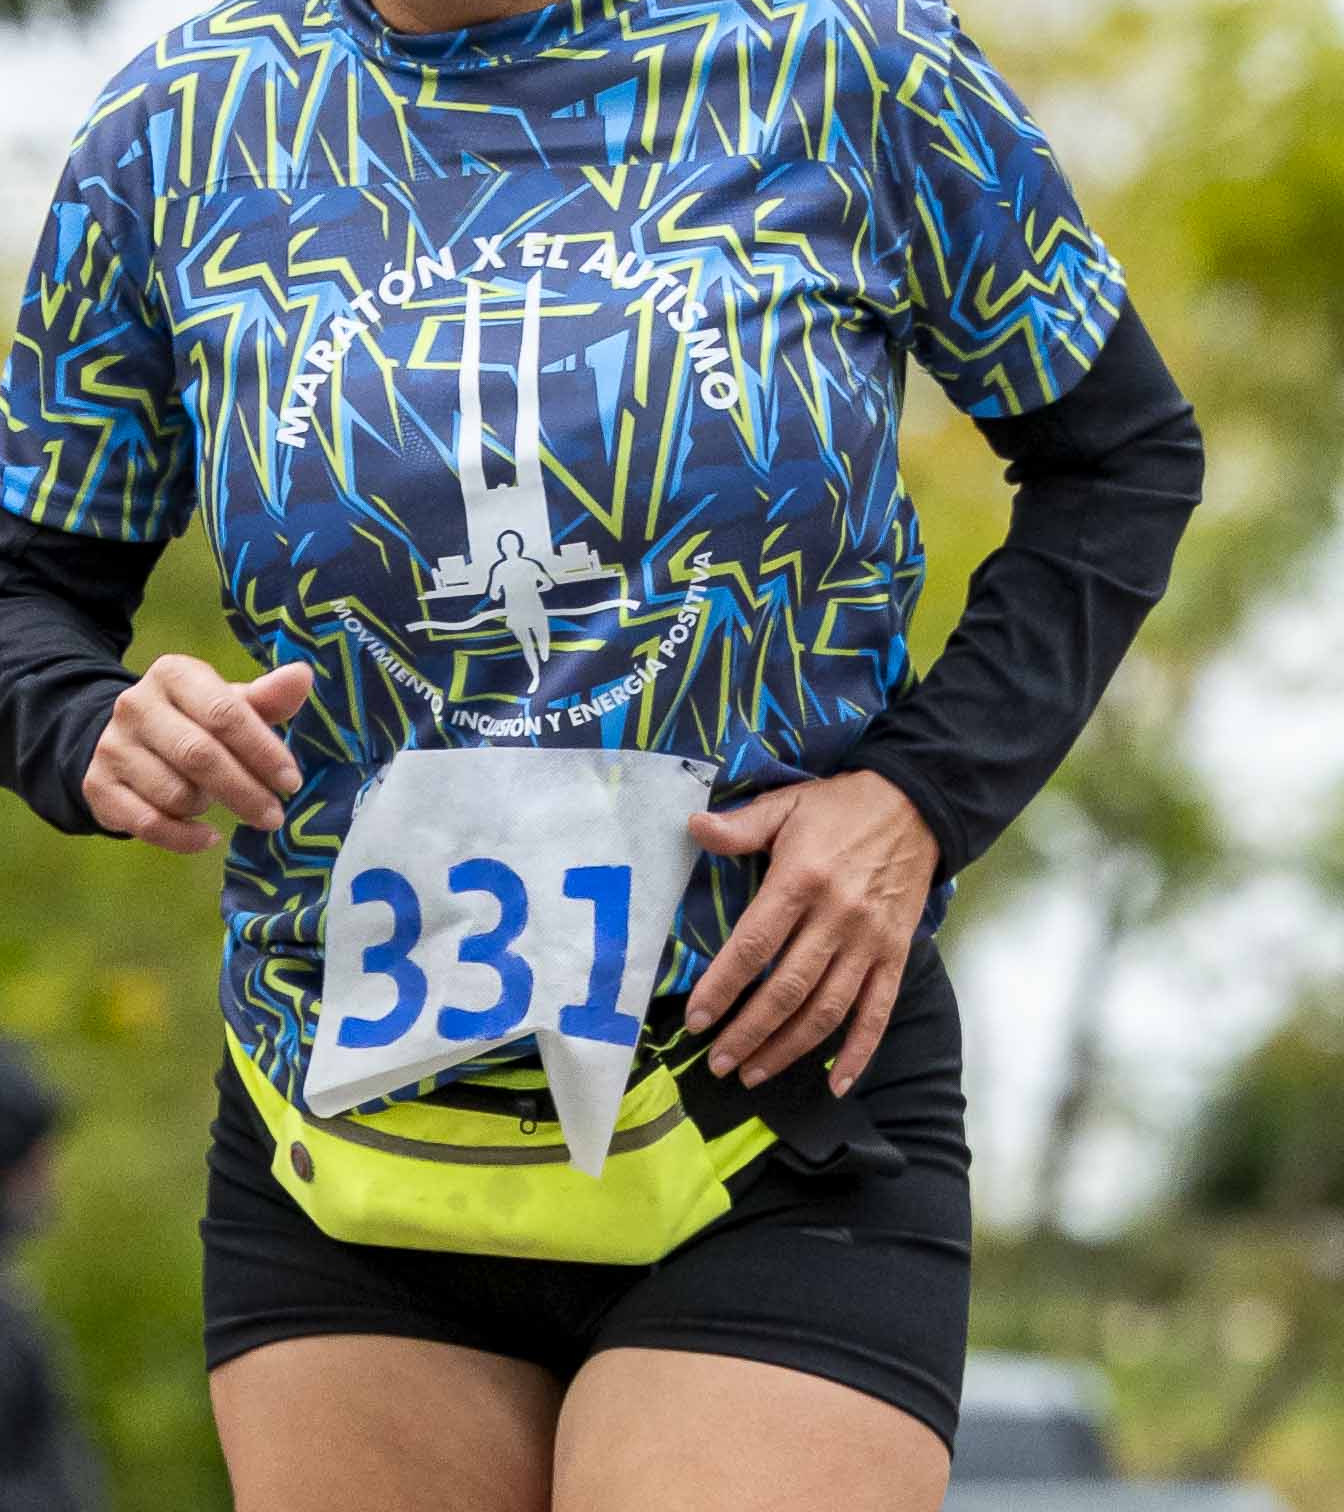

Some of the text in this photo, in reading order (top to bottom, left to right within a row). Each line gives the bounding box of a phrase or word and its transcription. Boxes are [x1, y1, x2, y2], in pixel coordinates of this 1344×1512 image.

[275, 231, 740, 450] MARATÓN X EL AUTISMO
[545, 711, 562, 733] Y
[567, 661, 668, 728] ENERGÍA
[659, 551, 713, 659] POSITIVA
[336, 858, 643, 1049] 331
